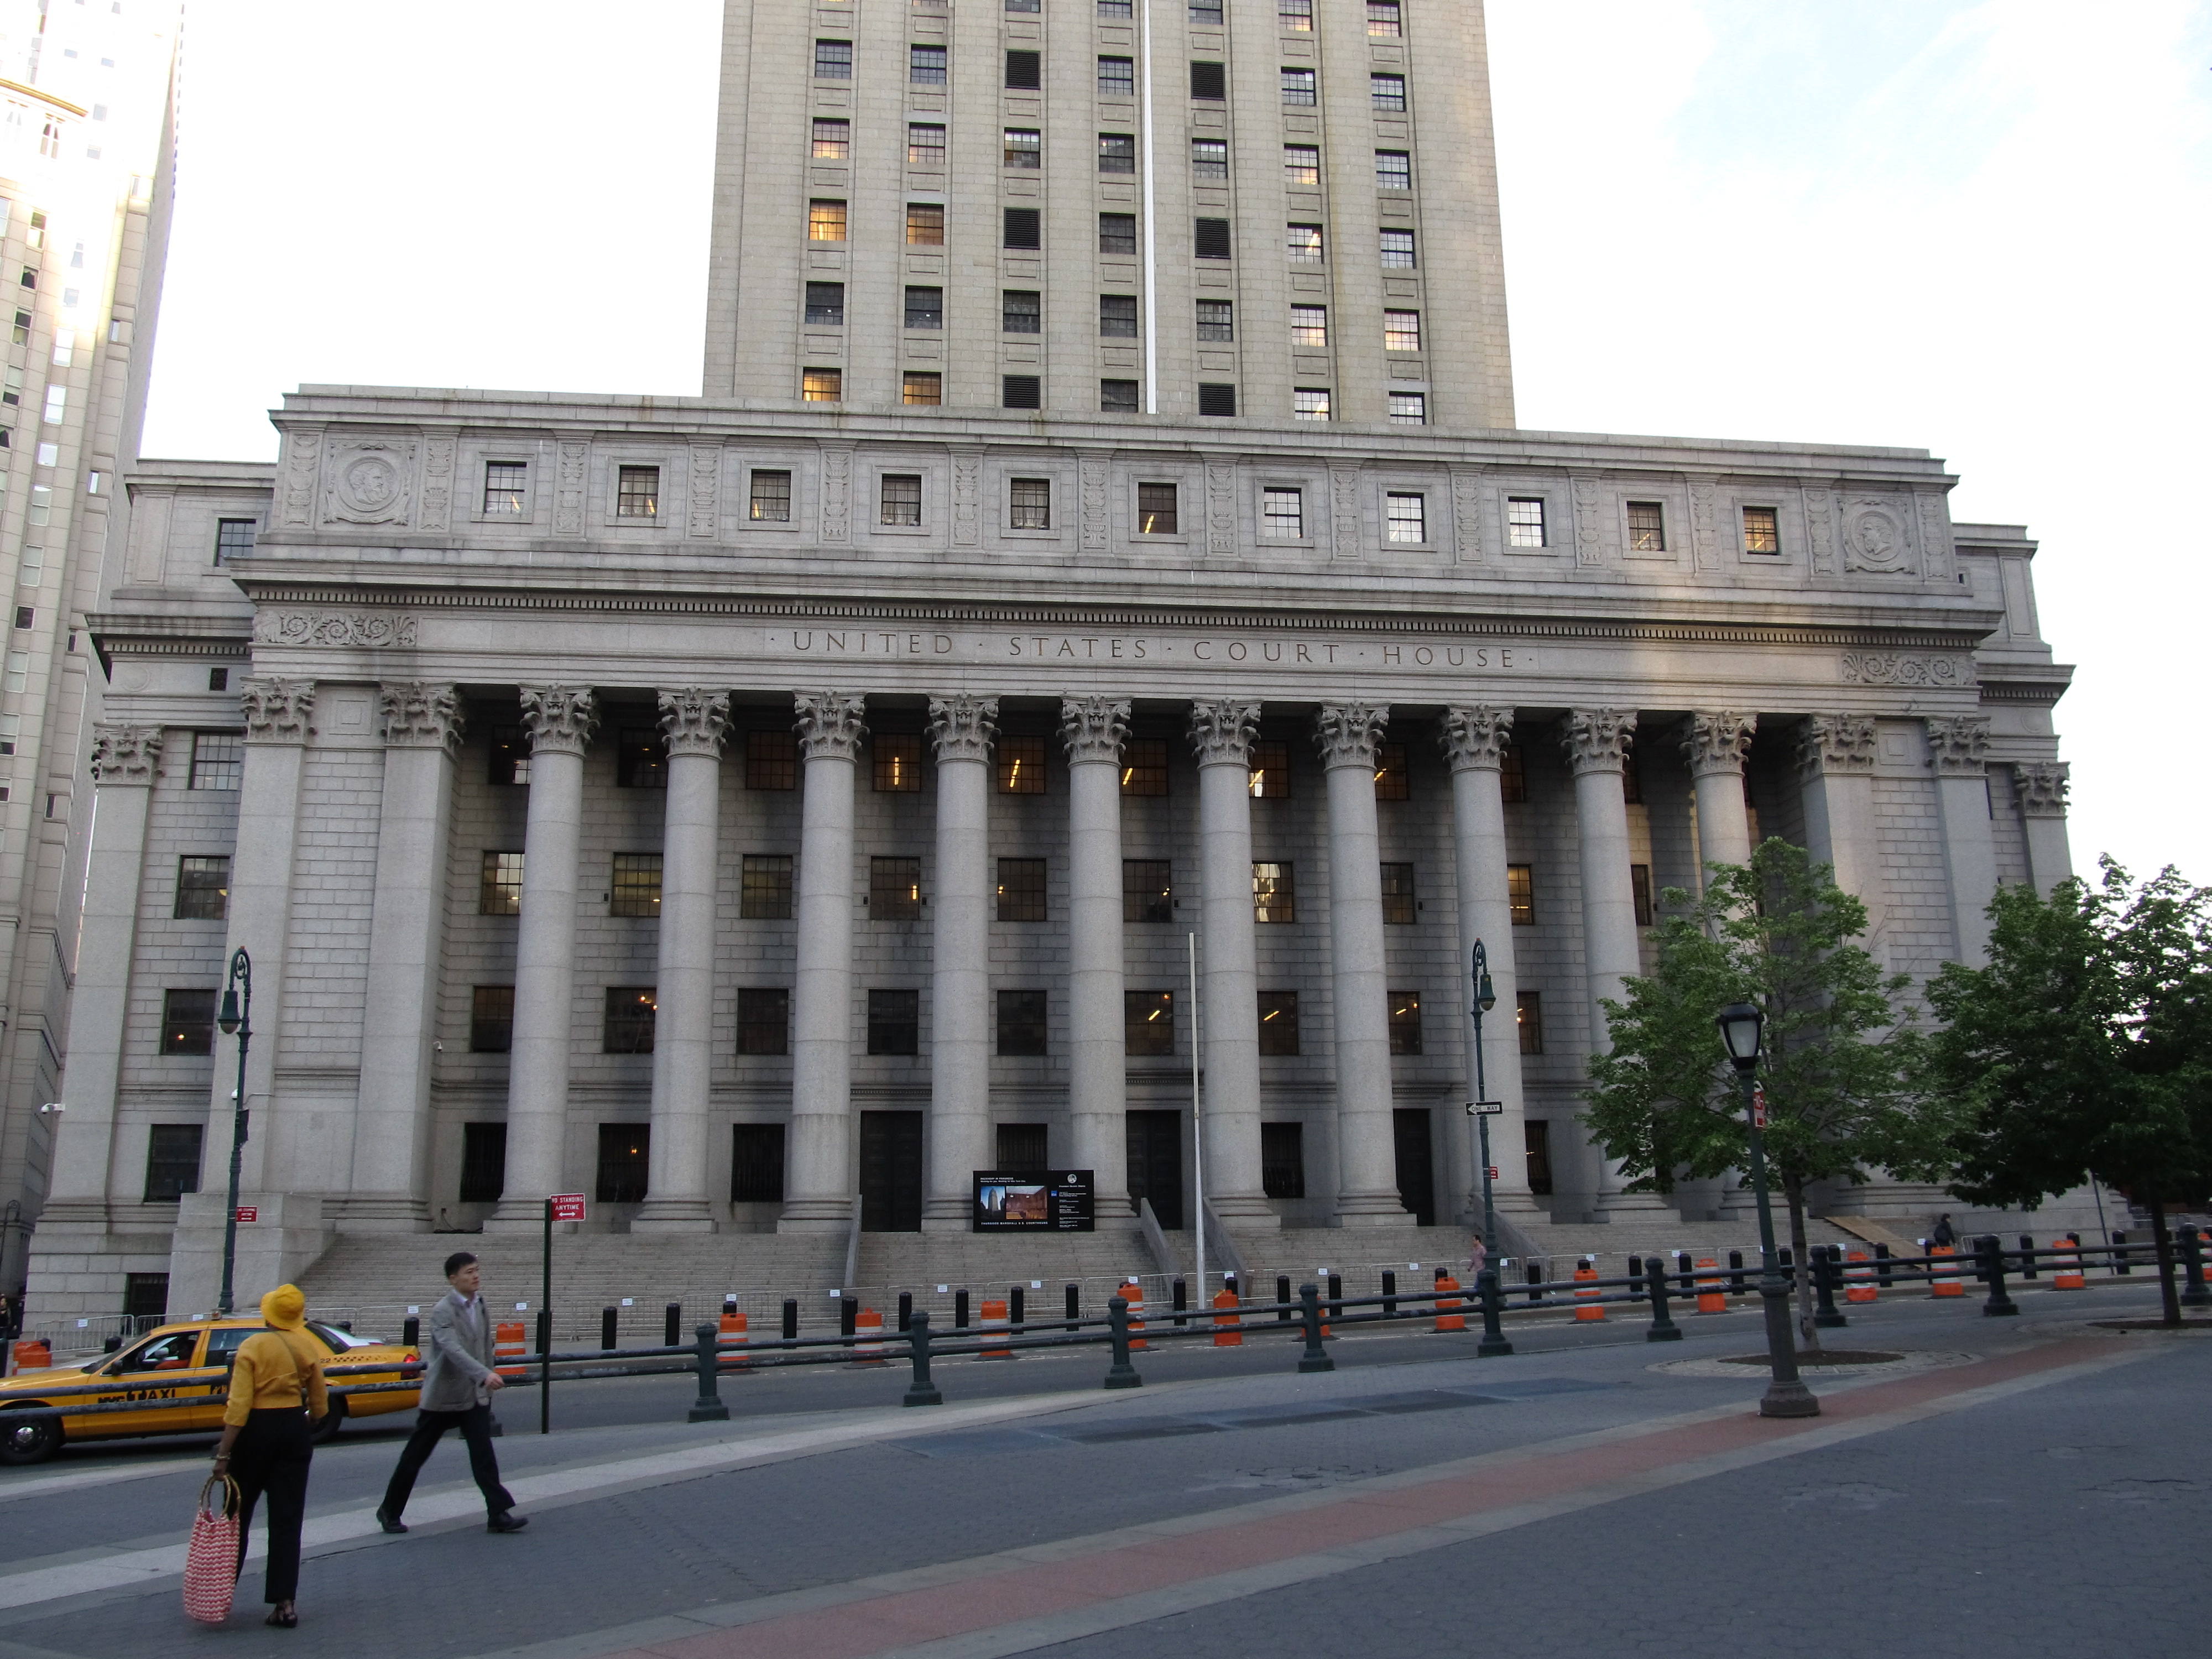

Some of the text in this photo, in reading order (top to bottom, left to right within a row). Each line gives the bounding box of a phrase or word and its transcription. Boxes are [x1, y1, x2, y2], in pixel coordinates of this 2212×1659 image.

[792, 631, 1514, 667] UNITED STATES COURT HOUSE
[127, 1389, 176, 1401] TAXI
